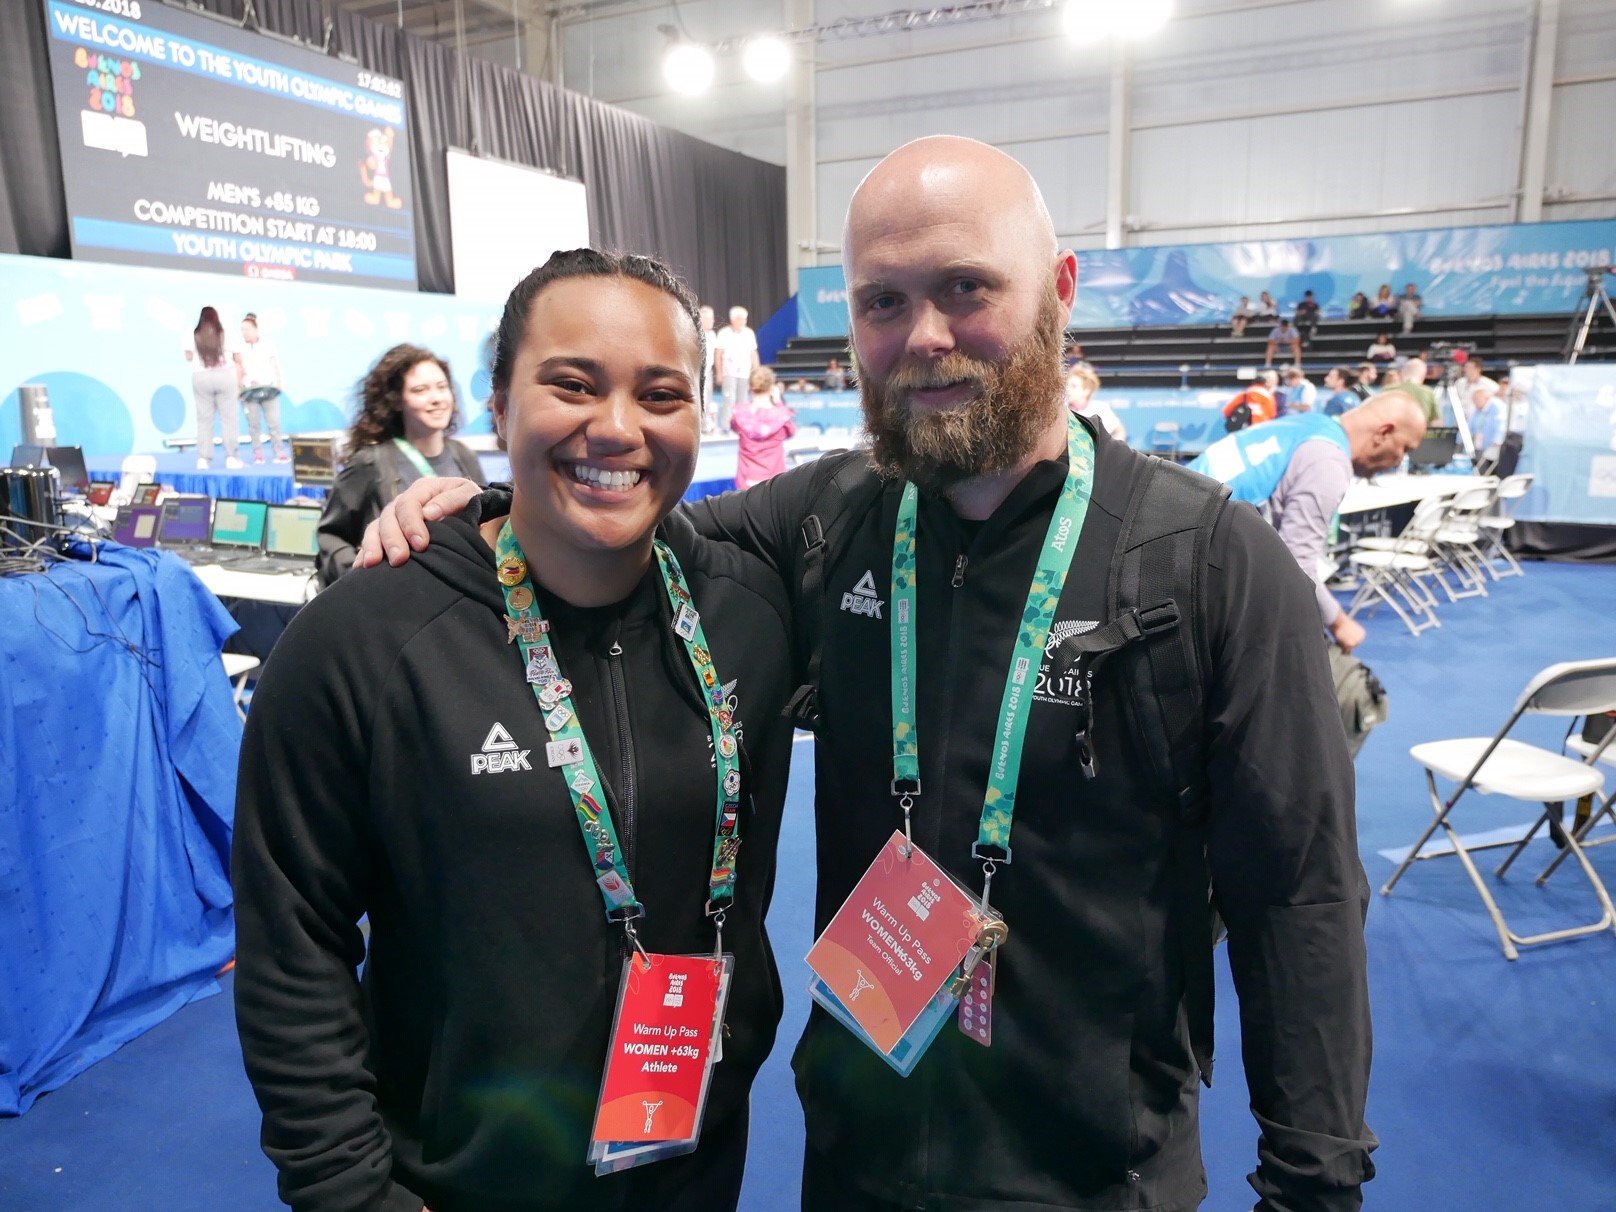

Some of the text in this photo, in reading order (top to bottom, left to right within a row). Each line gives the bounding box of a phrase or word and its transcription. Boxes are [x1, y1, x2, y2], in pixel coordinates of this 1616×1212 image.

[54, 9, 166, 61] WELCOME
[168, 41, 196, 67] TO
[197, 49, 232, 78] THE
[232, 59, 289, 93] YOUTH
[290, 75, 353, 112] OLYMPIC
[89, 87, 136, 117] 2018
[174, 110, 337, 168] WEIGHTLIFTING
[207, 181, 261, 208] MEN'S
[296, 195, 321, 217] KG
[133, 199, 265, 237] COMPETITION
[266, 218, 315, 243] START
[316, 226, 336, 247] AT
[172, 232, 353, 272] YOUTH OLYMPIC PARK
[839, 591, 885, 620] PEAK
[899, 626, 908, 648] 2018
[1032, 694, 1048, 702] OUTH
[995, 686, 1021, 781] BUENOS AIRES 2018
[470, 749, 533, 775] PEAK
[872, 896, 899, 928] Warm
[898, 926, 912, 943] Up
[911, 938, 932, 966] Pass
[866, 934, 903, 976] Team Official
[668, 985, 682, 994] 2018
[633, 1023, 698, 1039] Warm Up Pass
[623, 1042, 700, 1060] WOMEN +63kg
[641, 1060, 678, 1073] Athlete
